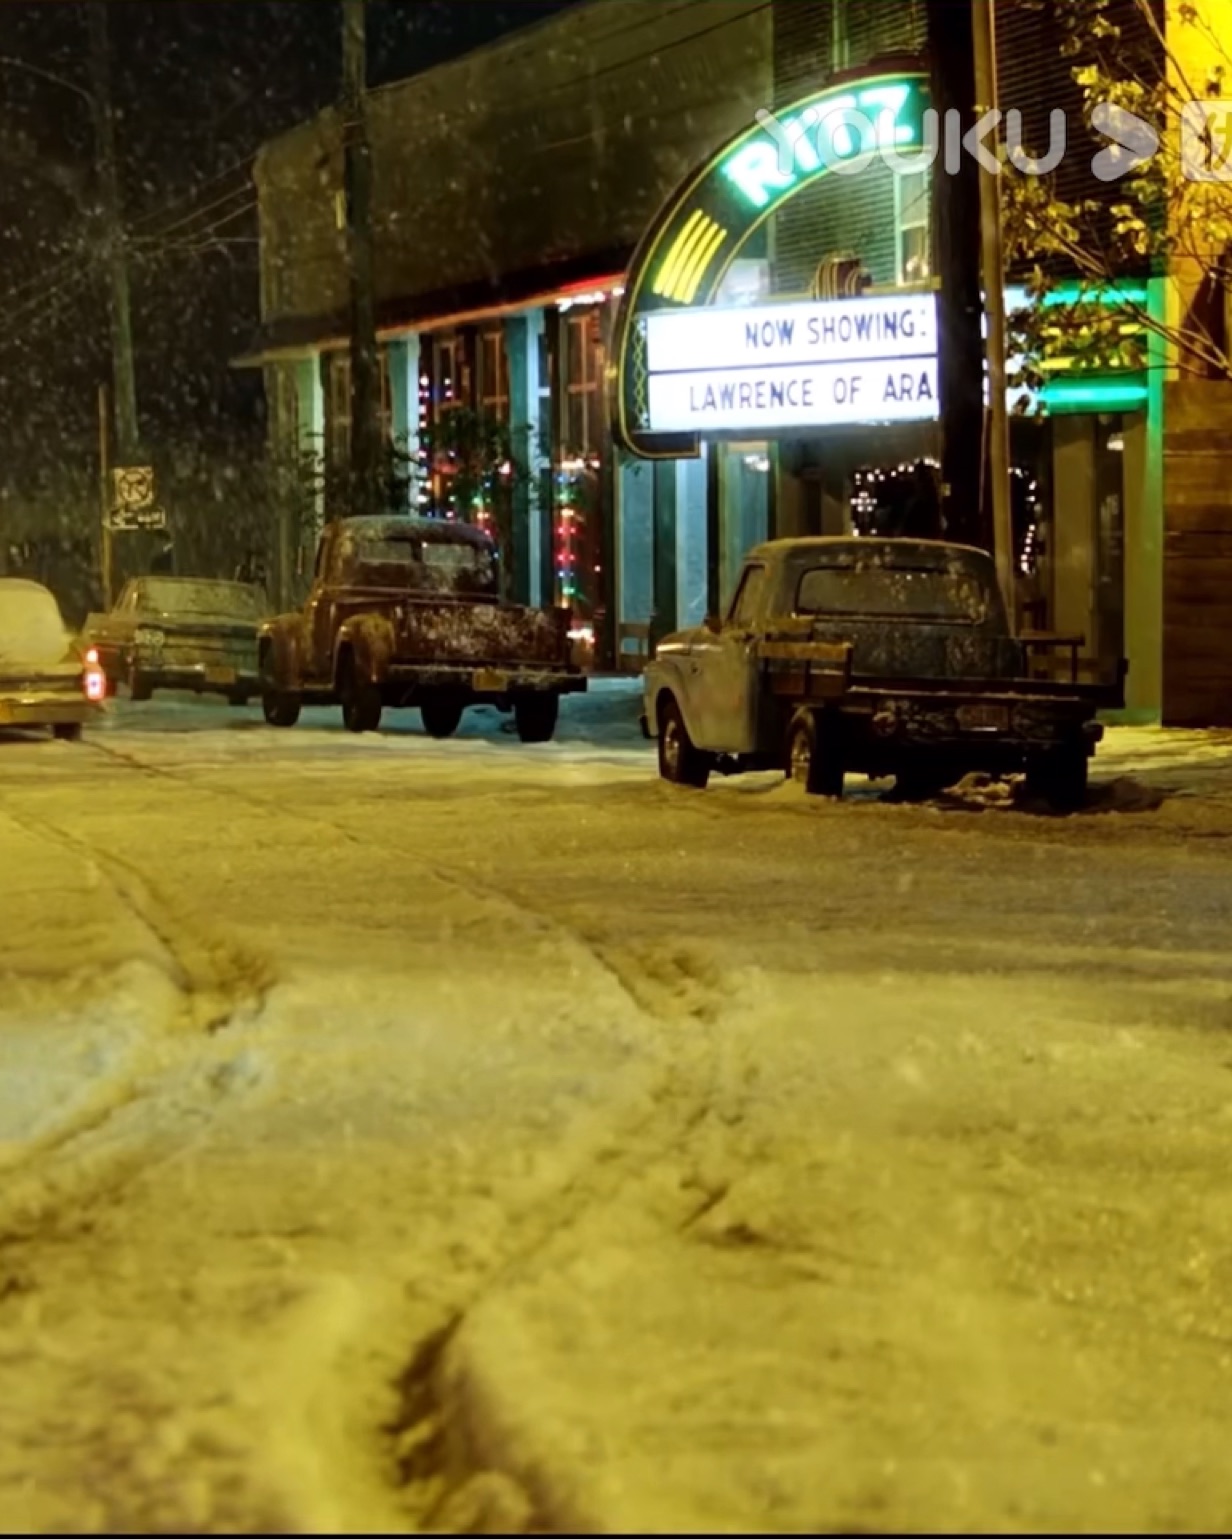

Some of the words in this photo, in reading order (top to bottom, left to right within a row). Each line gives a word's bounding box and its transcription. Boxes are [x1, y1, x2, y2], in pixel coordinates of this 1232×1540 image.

[721, 84, 914, 208] RITZ
[745, 319, 795, 349] NOW
[807, 308, 927, 345] SHOWING:
[689, 378, 814, 412] LAWRENCE
[832, 375, 863, 405] OF
